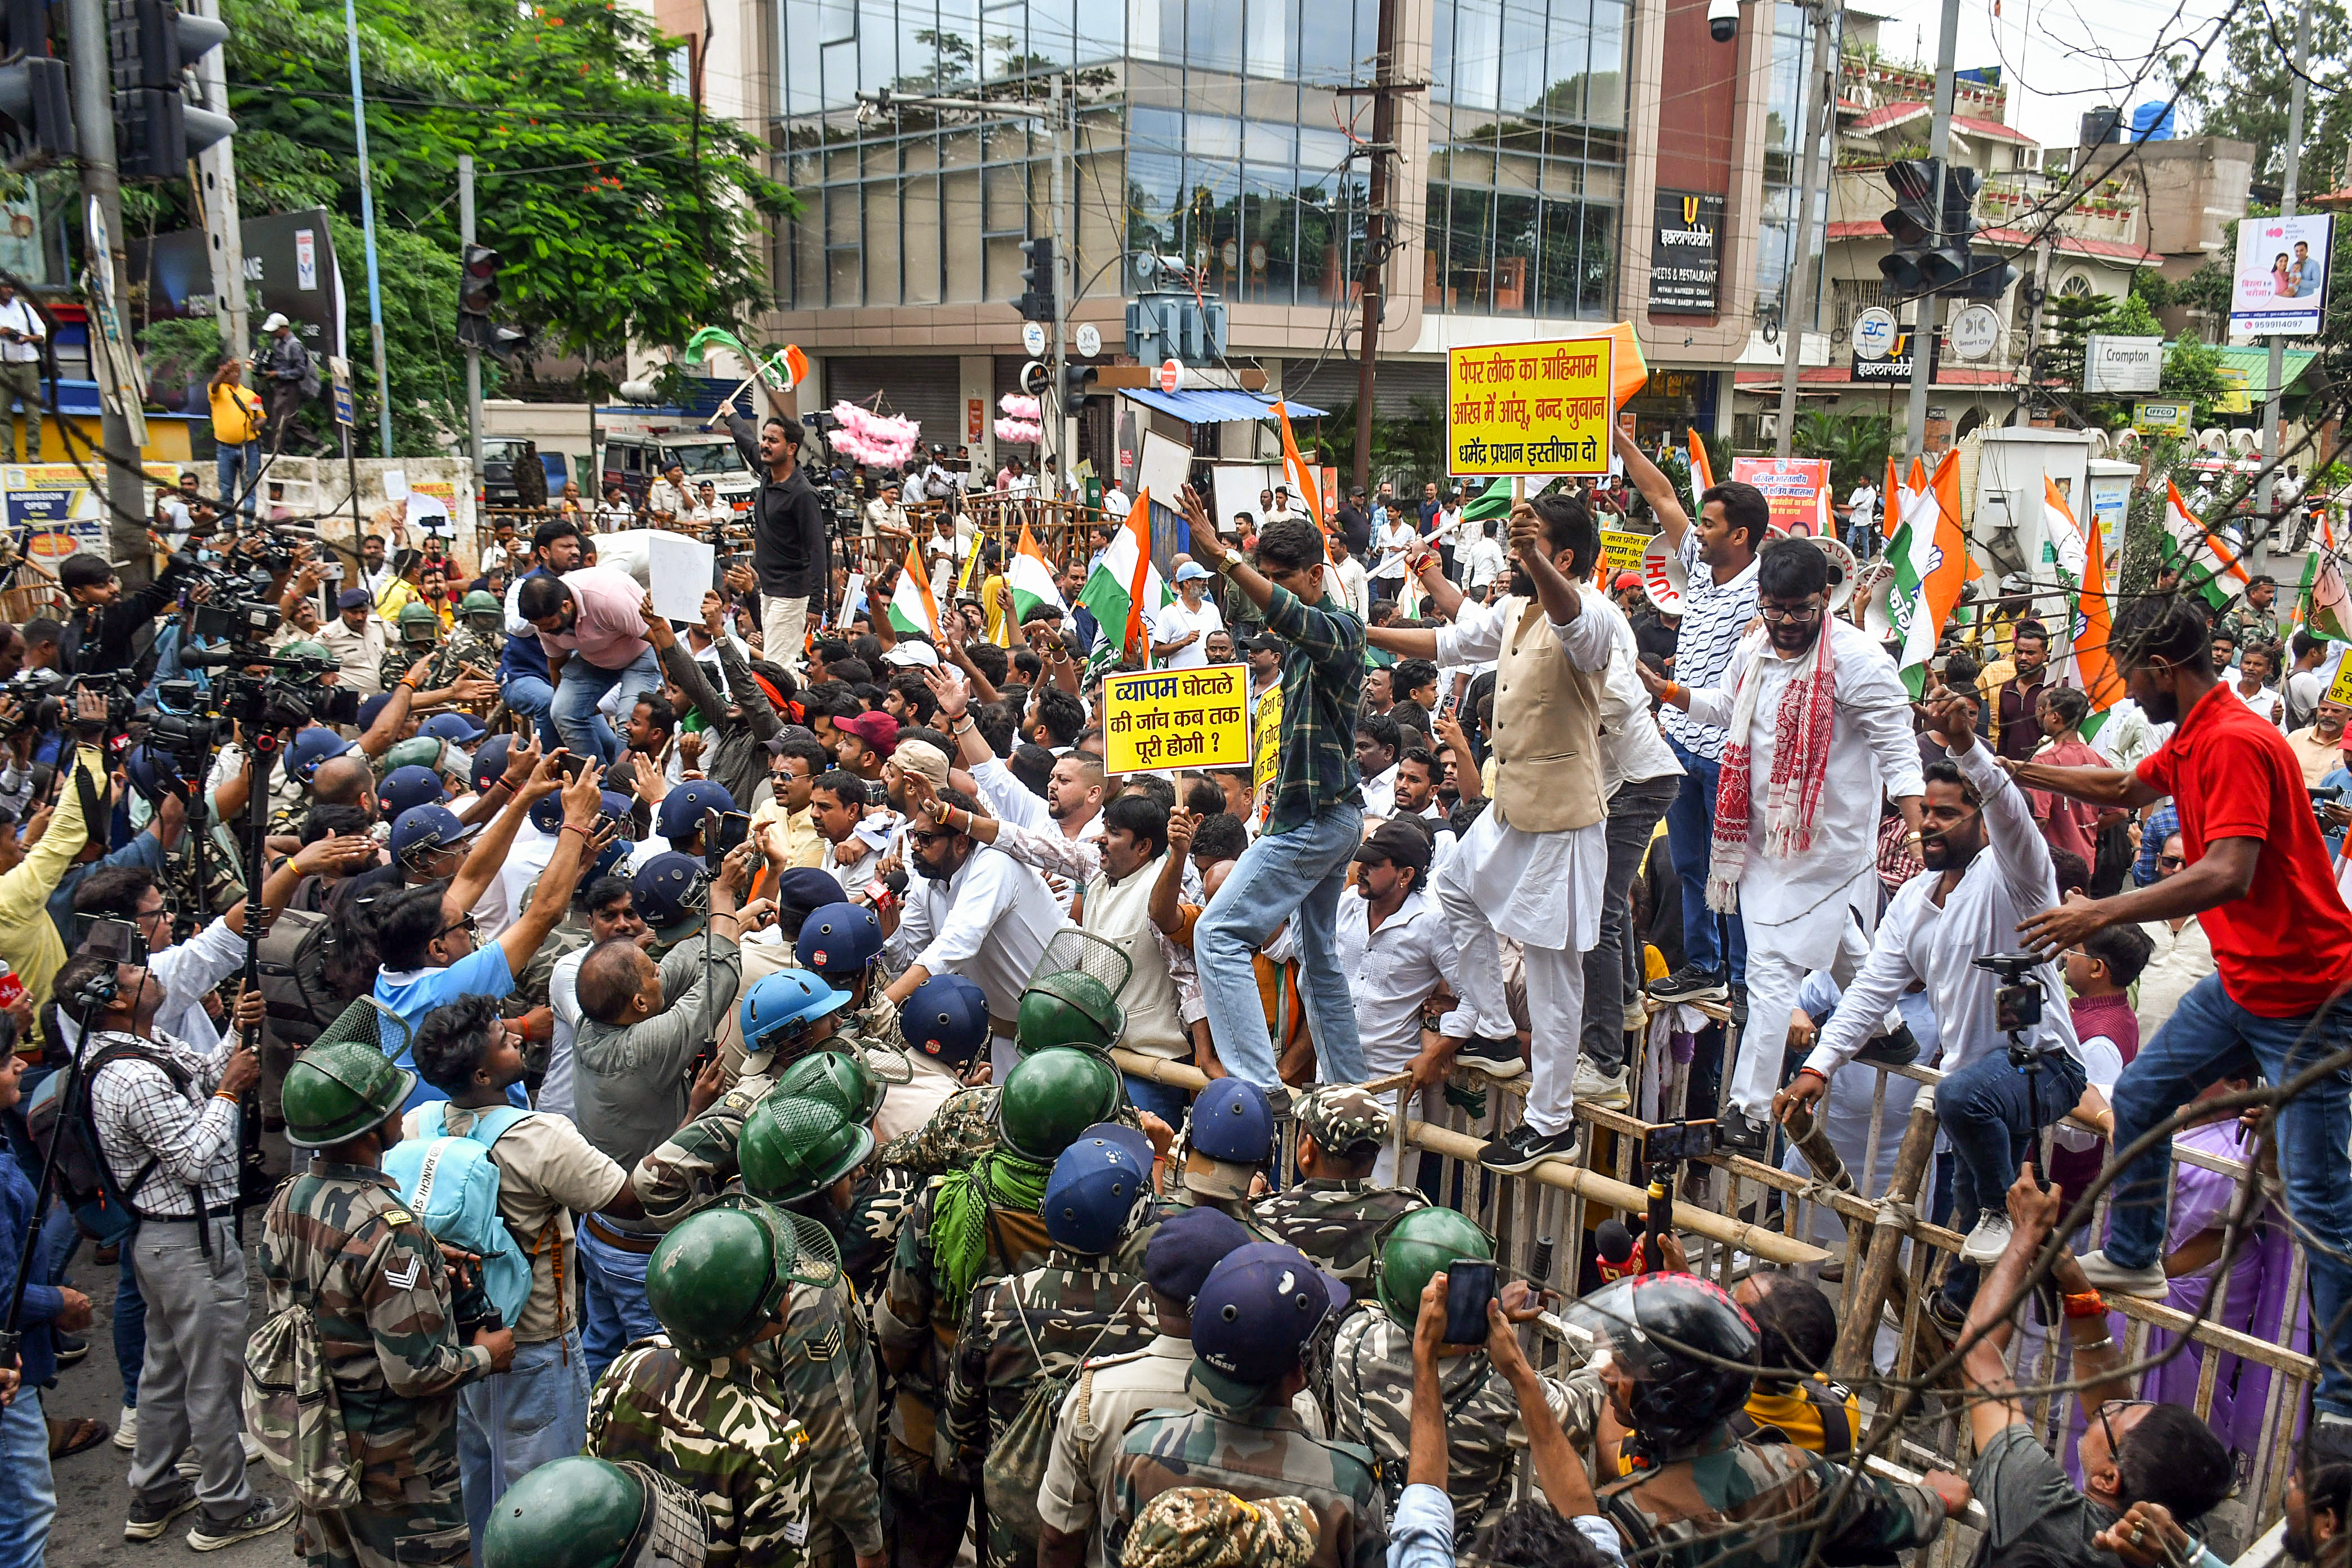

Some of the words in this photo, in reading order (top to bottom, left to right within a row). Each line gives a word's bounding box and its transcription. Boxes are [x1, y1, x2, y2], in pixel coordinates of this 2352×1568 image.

[1672, 268, 1678, 280] &
[1679, 269, 1717, 283] RESTAURANT
[1459, 355, 1485, 384] पेपर
[1487, 351, 1516, 384] लीक
[1519, 358, 1538, 381] का
[2106, 348, 2149, 365] Crompton
[1453, 393, 1481, 425] आंख
[1484, 391, 1496, 423] में
[1535, 398, 1563, 421] बन्द
[1566, 397, 1606, 430] जुबान
[1490, 443, 1524, 466] प्रधान
[1527, 435, 1579, 466] इस्तीफा
[1582, 435, 1597, 462] दो
[24, 501, 53, 510] OPEN
[1605, 545, 1628, 555] यापम
[1623, 536, 1640, 545] प्रदेश
[1823, 542, 1852, 581] JUHI
[1645, 555, 1680, 604] JUHI
[1115, 677, 1179, 702] व्यापम
[1182, 672, 1235, 697] घोटाले
[1110, 711, 1132, 733] की
[1136, 706, 1170, 730] जांच
[1174, 709, 1204, 727] कब
[1209, 706, 1241, 725] तक
[1135, 735, 1162, 765] पूरी
[1166, 731, 1205, 756] होगी
[1211, 732, 1220, 753] ?
[418, 1157, 435, 1197] RANCHI
[389, 1211, 409, 1222] IRB
